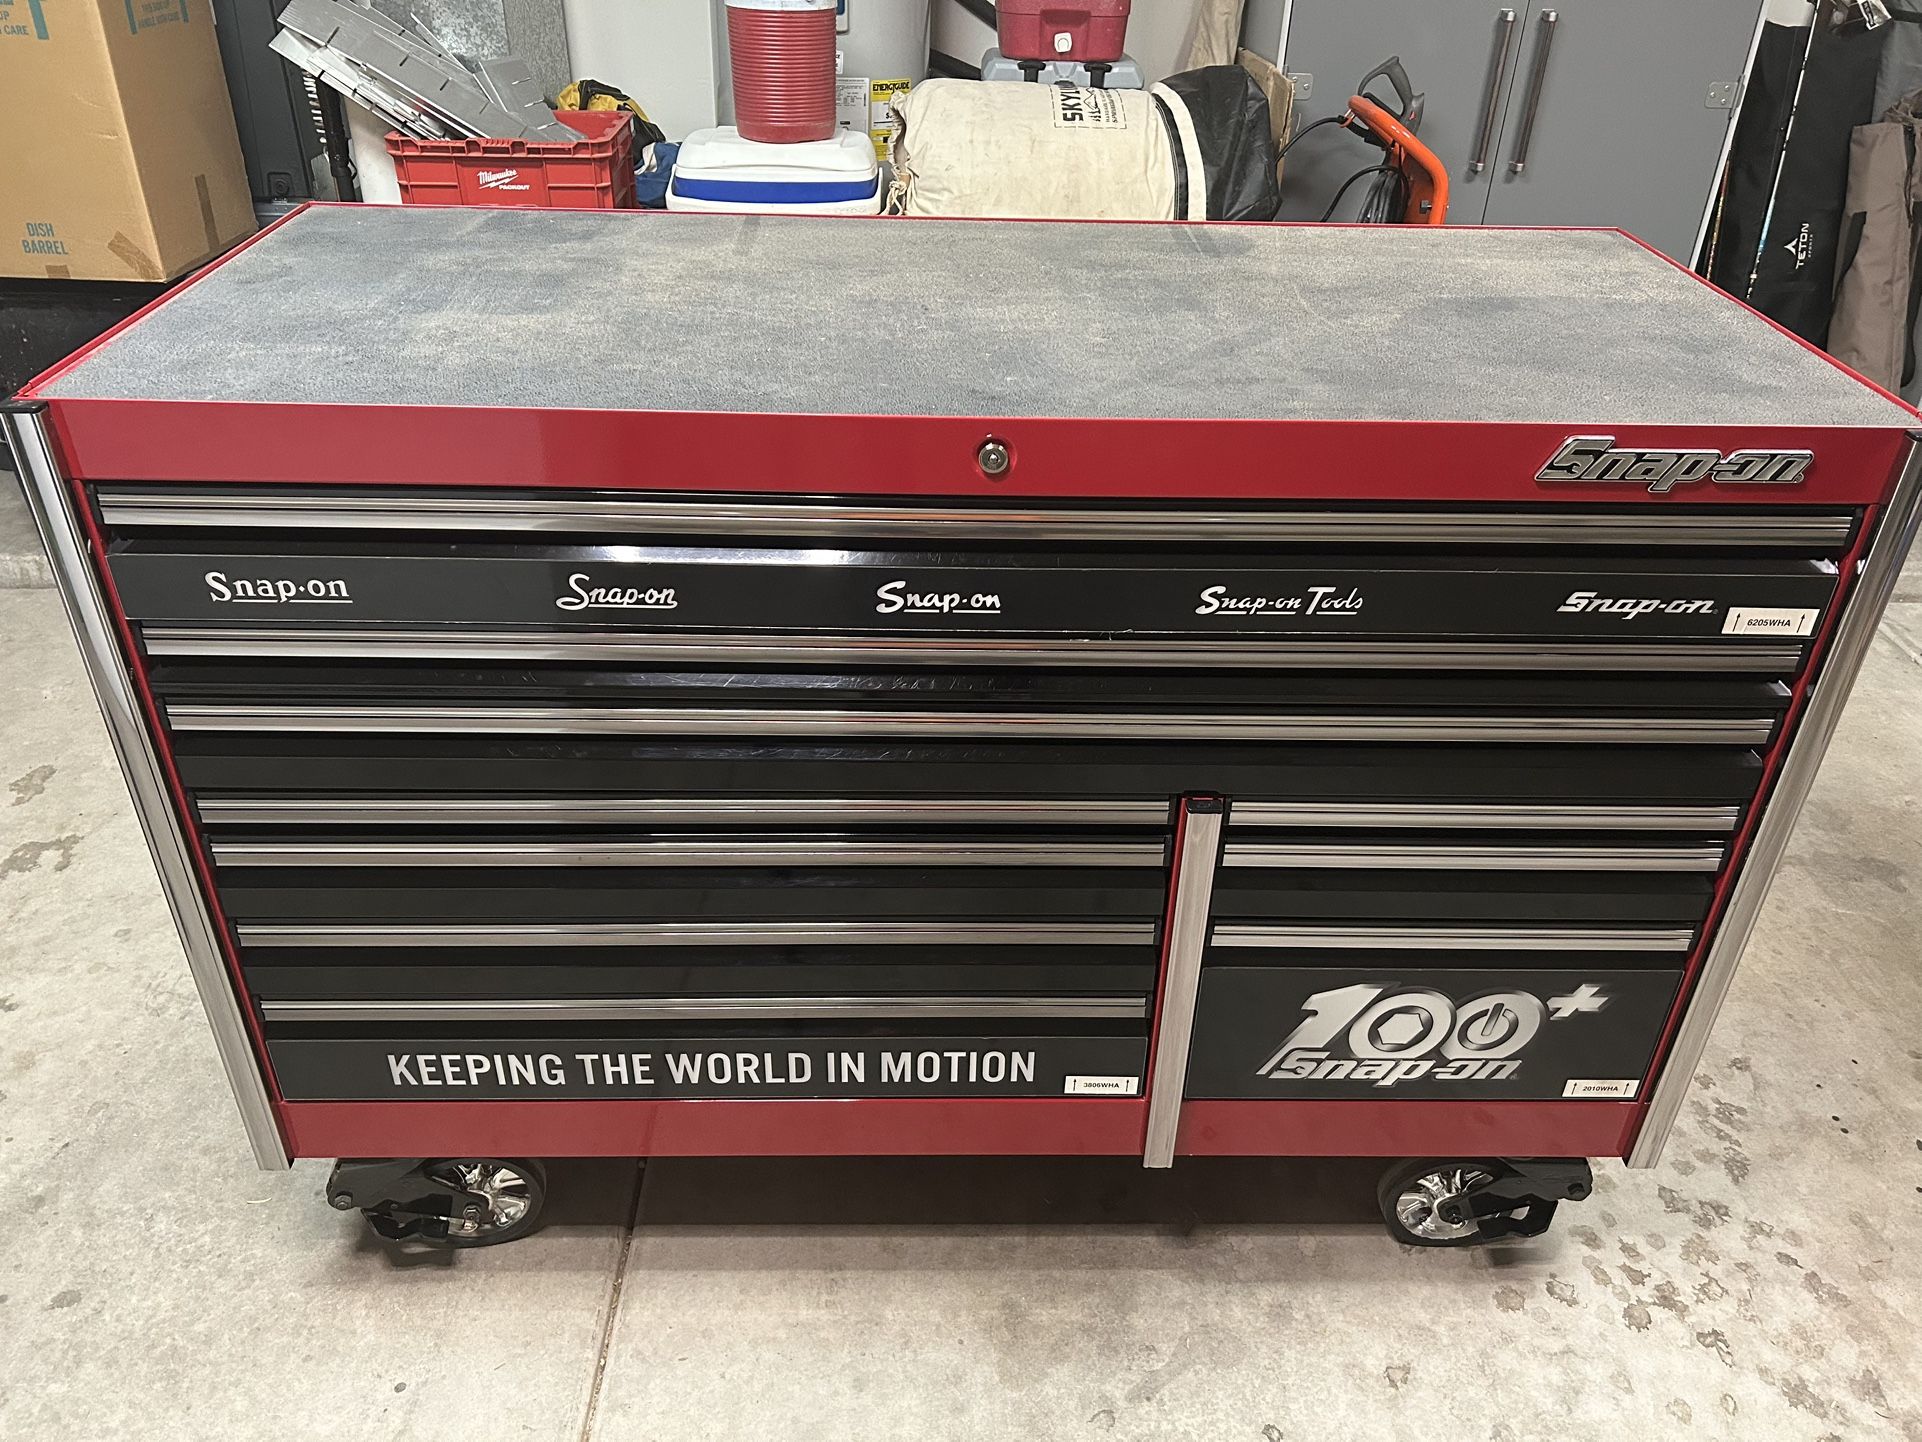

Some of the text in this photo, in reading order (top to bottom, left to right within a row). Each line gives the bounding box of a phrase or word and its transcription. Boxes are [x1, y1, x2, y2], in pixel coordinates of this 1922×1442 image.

[4, 24, 29, 35] CARE
[477, 168, 518, 185] Milwaukee
[26, 222, 55, 237] DISH
[22, 239, 69, 255] BARREL
[1796, 223, 1809, 269] TETON
[1535, 435, 1813, 492] Snap-on
[1195, 585, 1363, 615] Snap-on Tools
[1556, 591, 1716, 620] Snap-on
[1747, 618, 1791, 627] 6205WHA
[387, 1050, 1036, 1086] KEEPING THE WORLD IN MOTION
[1268, 1050, 1522, 1088] Snap-on
